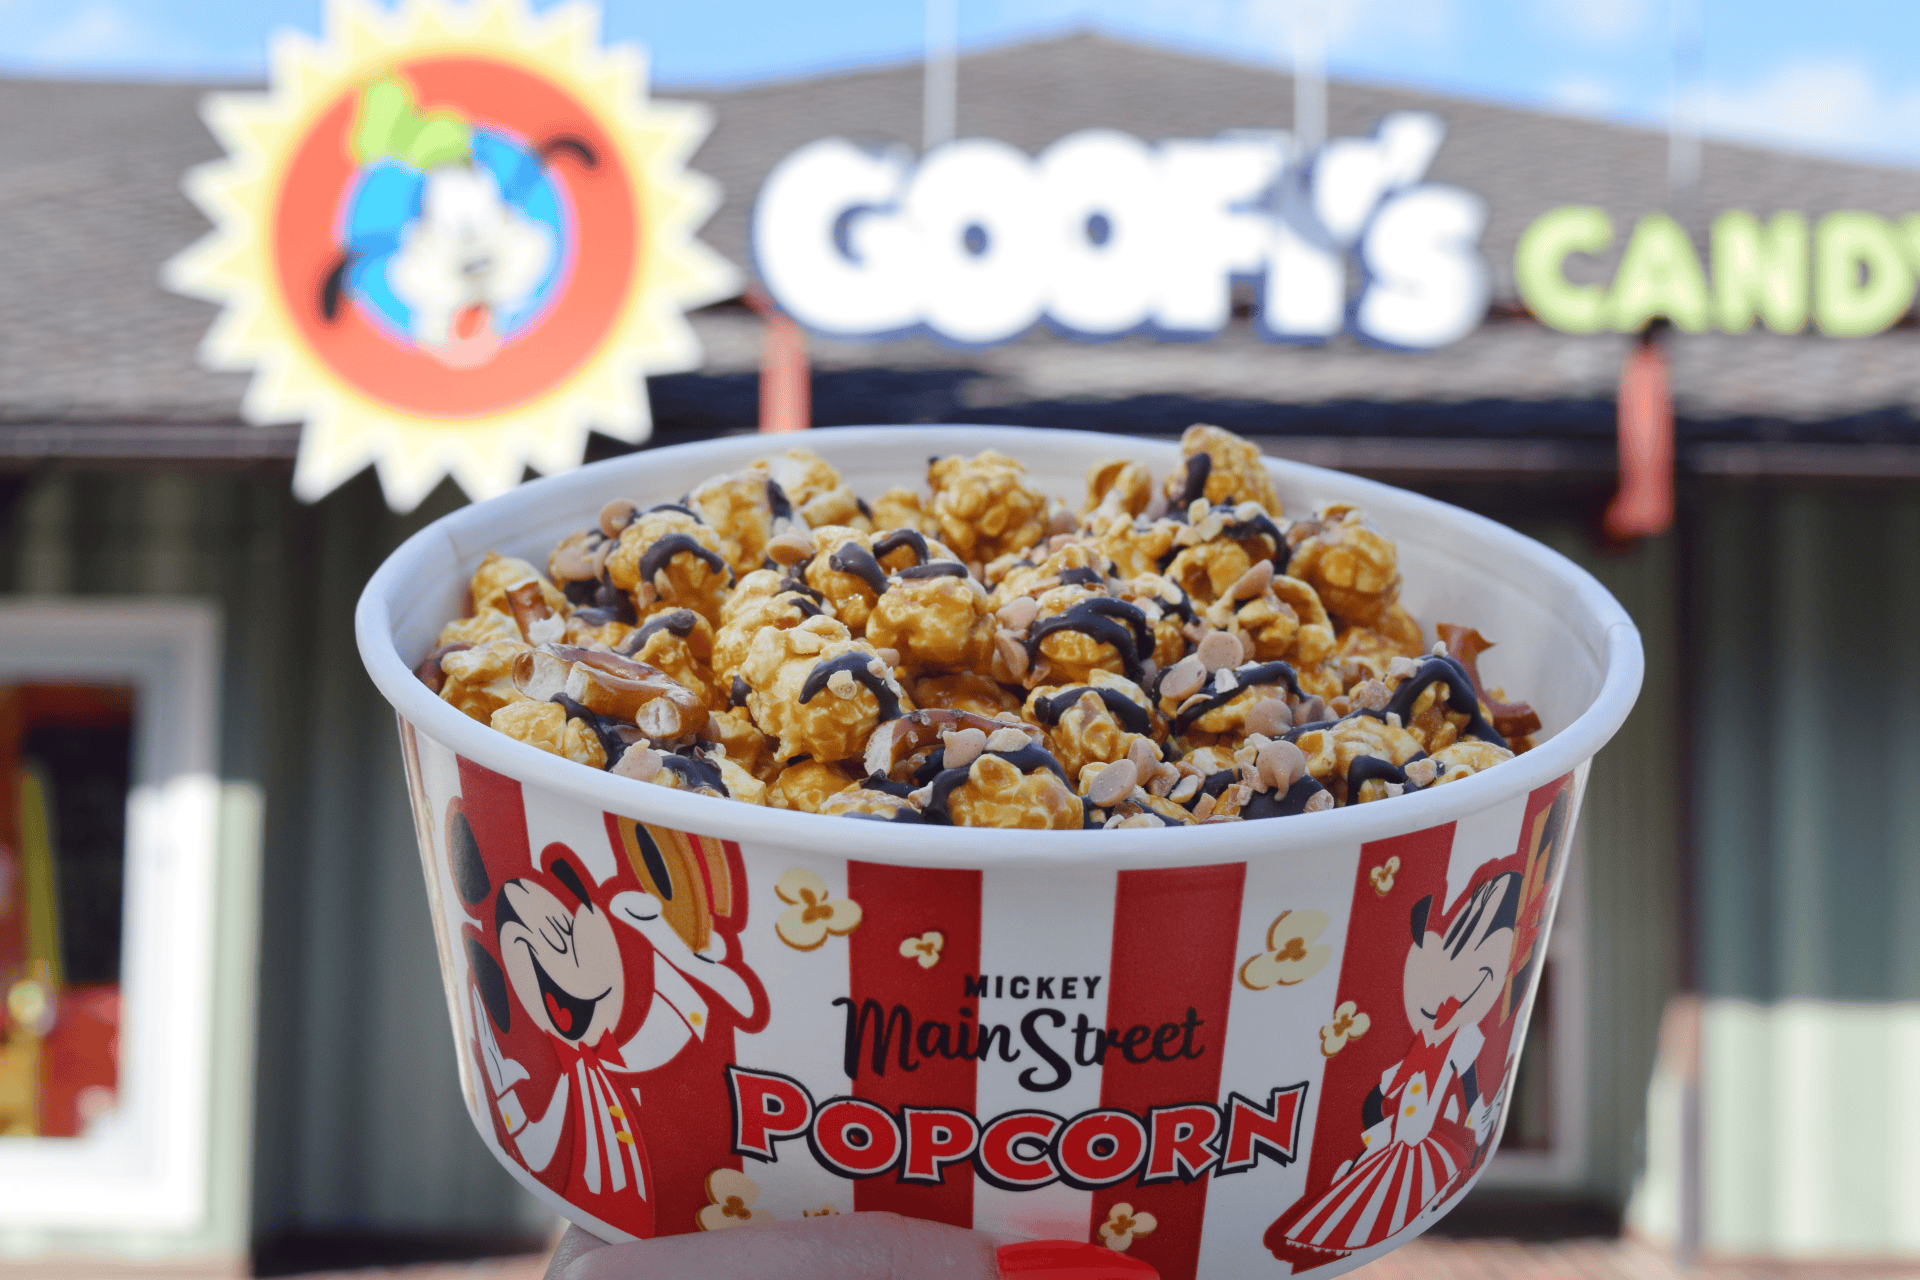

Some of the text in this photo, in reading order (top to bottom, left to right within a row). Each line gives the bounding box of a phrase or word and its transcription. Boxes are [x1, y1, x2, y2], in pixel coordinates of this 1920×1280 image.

[1514, 205, 1920, 337] CAND
[964, 975, 1103, 1000] MICKEY
[724, 1065, 1309, 1191] POPCORN
